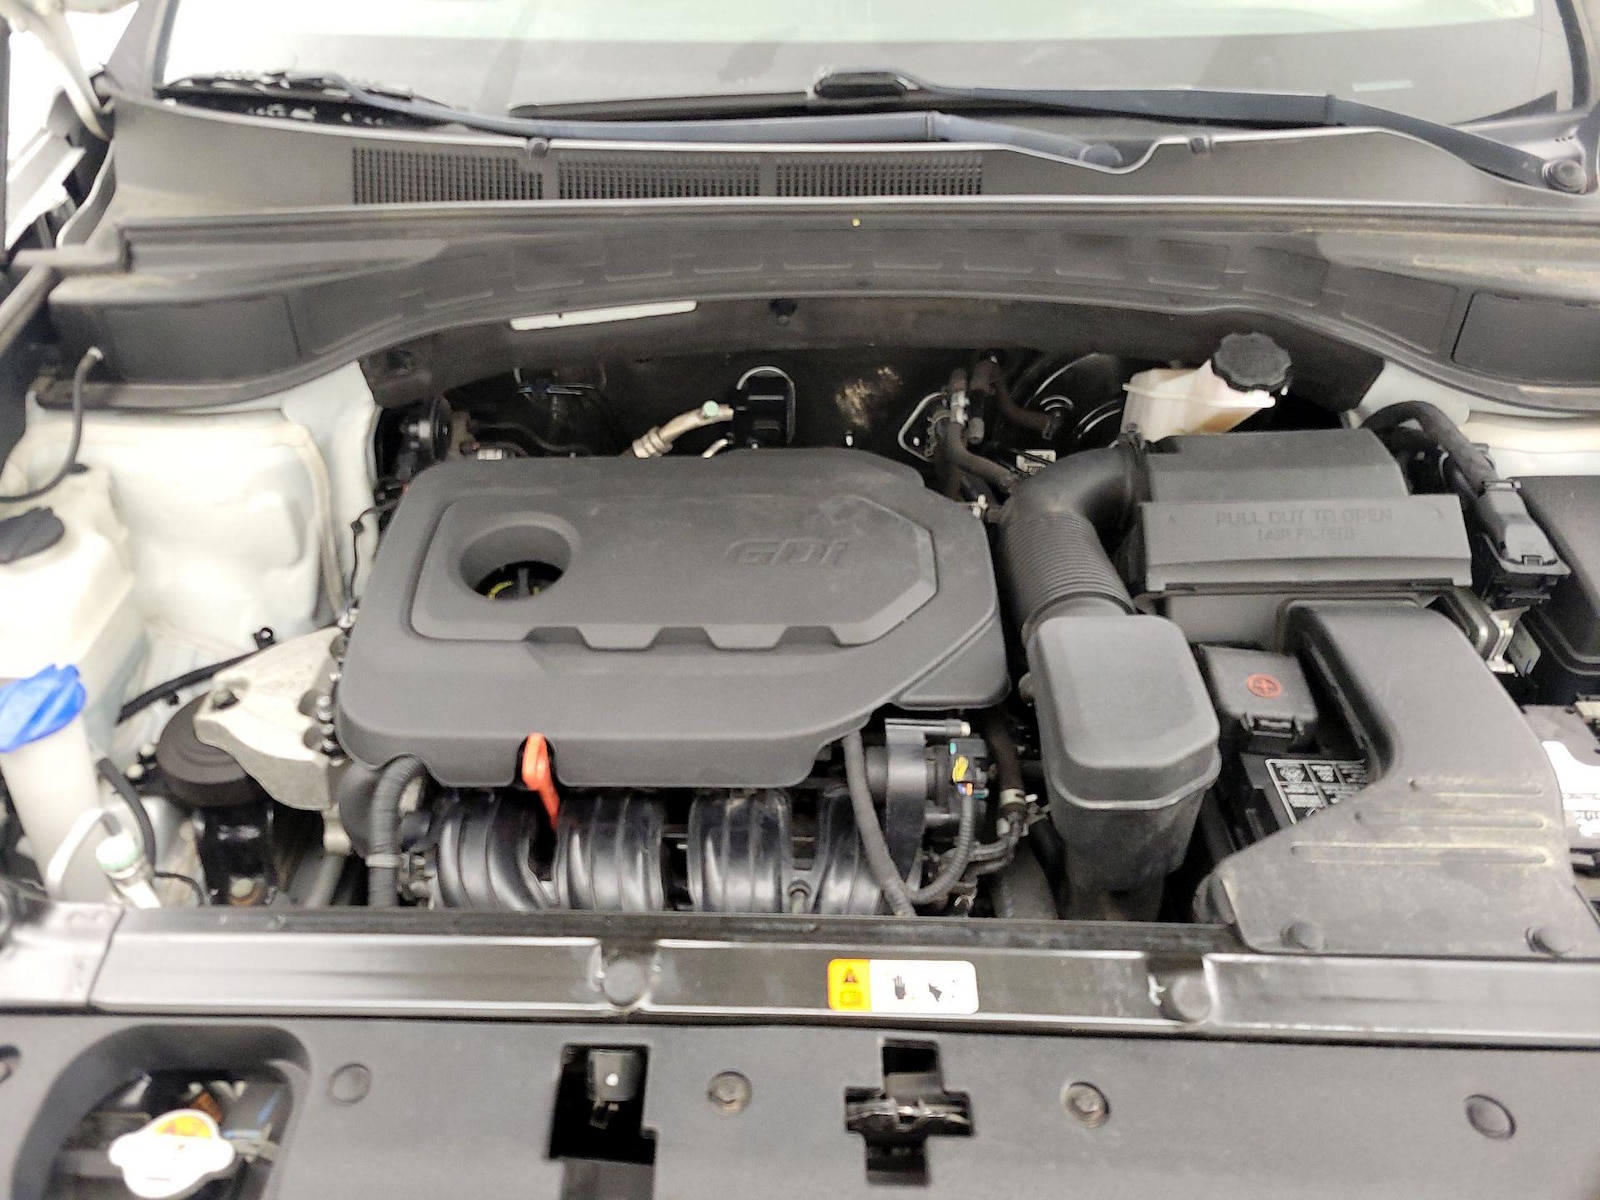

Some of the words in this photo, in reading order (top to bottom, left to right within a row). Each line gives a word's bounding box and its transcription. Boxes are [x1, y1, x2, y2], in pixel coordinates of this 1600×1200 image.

[1215, 510, 1262, 526] PULL
[1268, 509, 1304, 525] OUT
[1311, 509, 1336, 523] TO
[1342, 507, 1393, 523] OPEN
